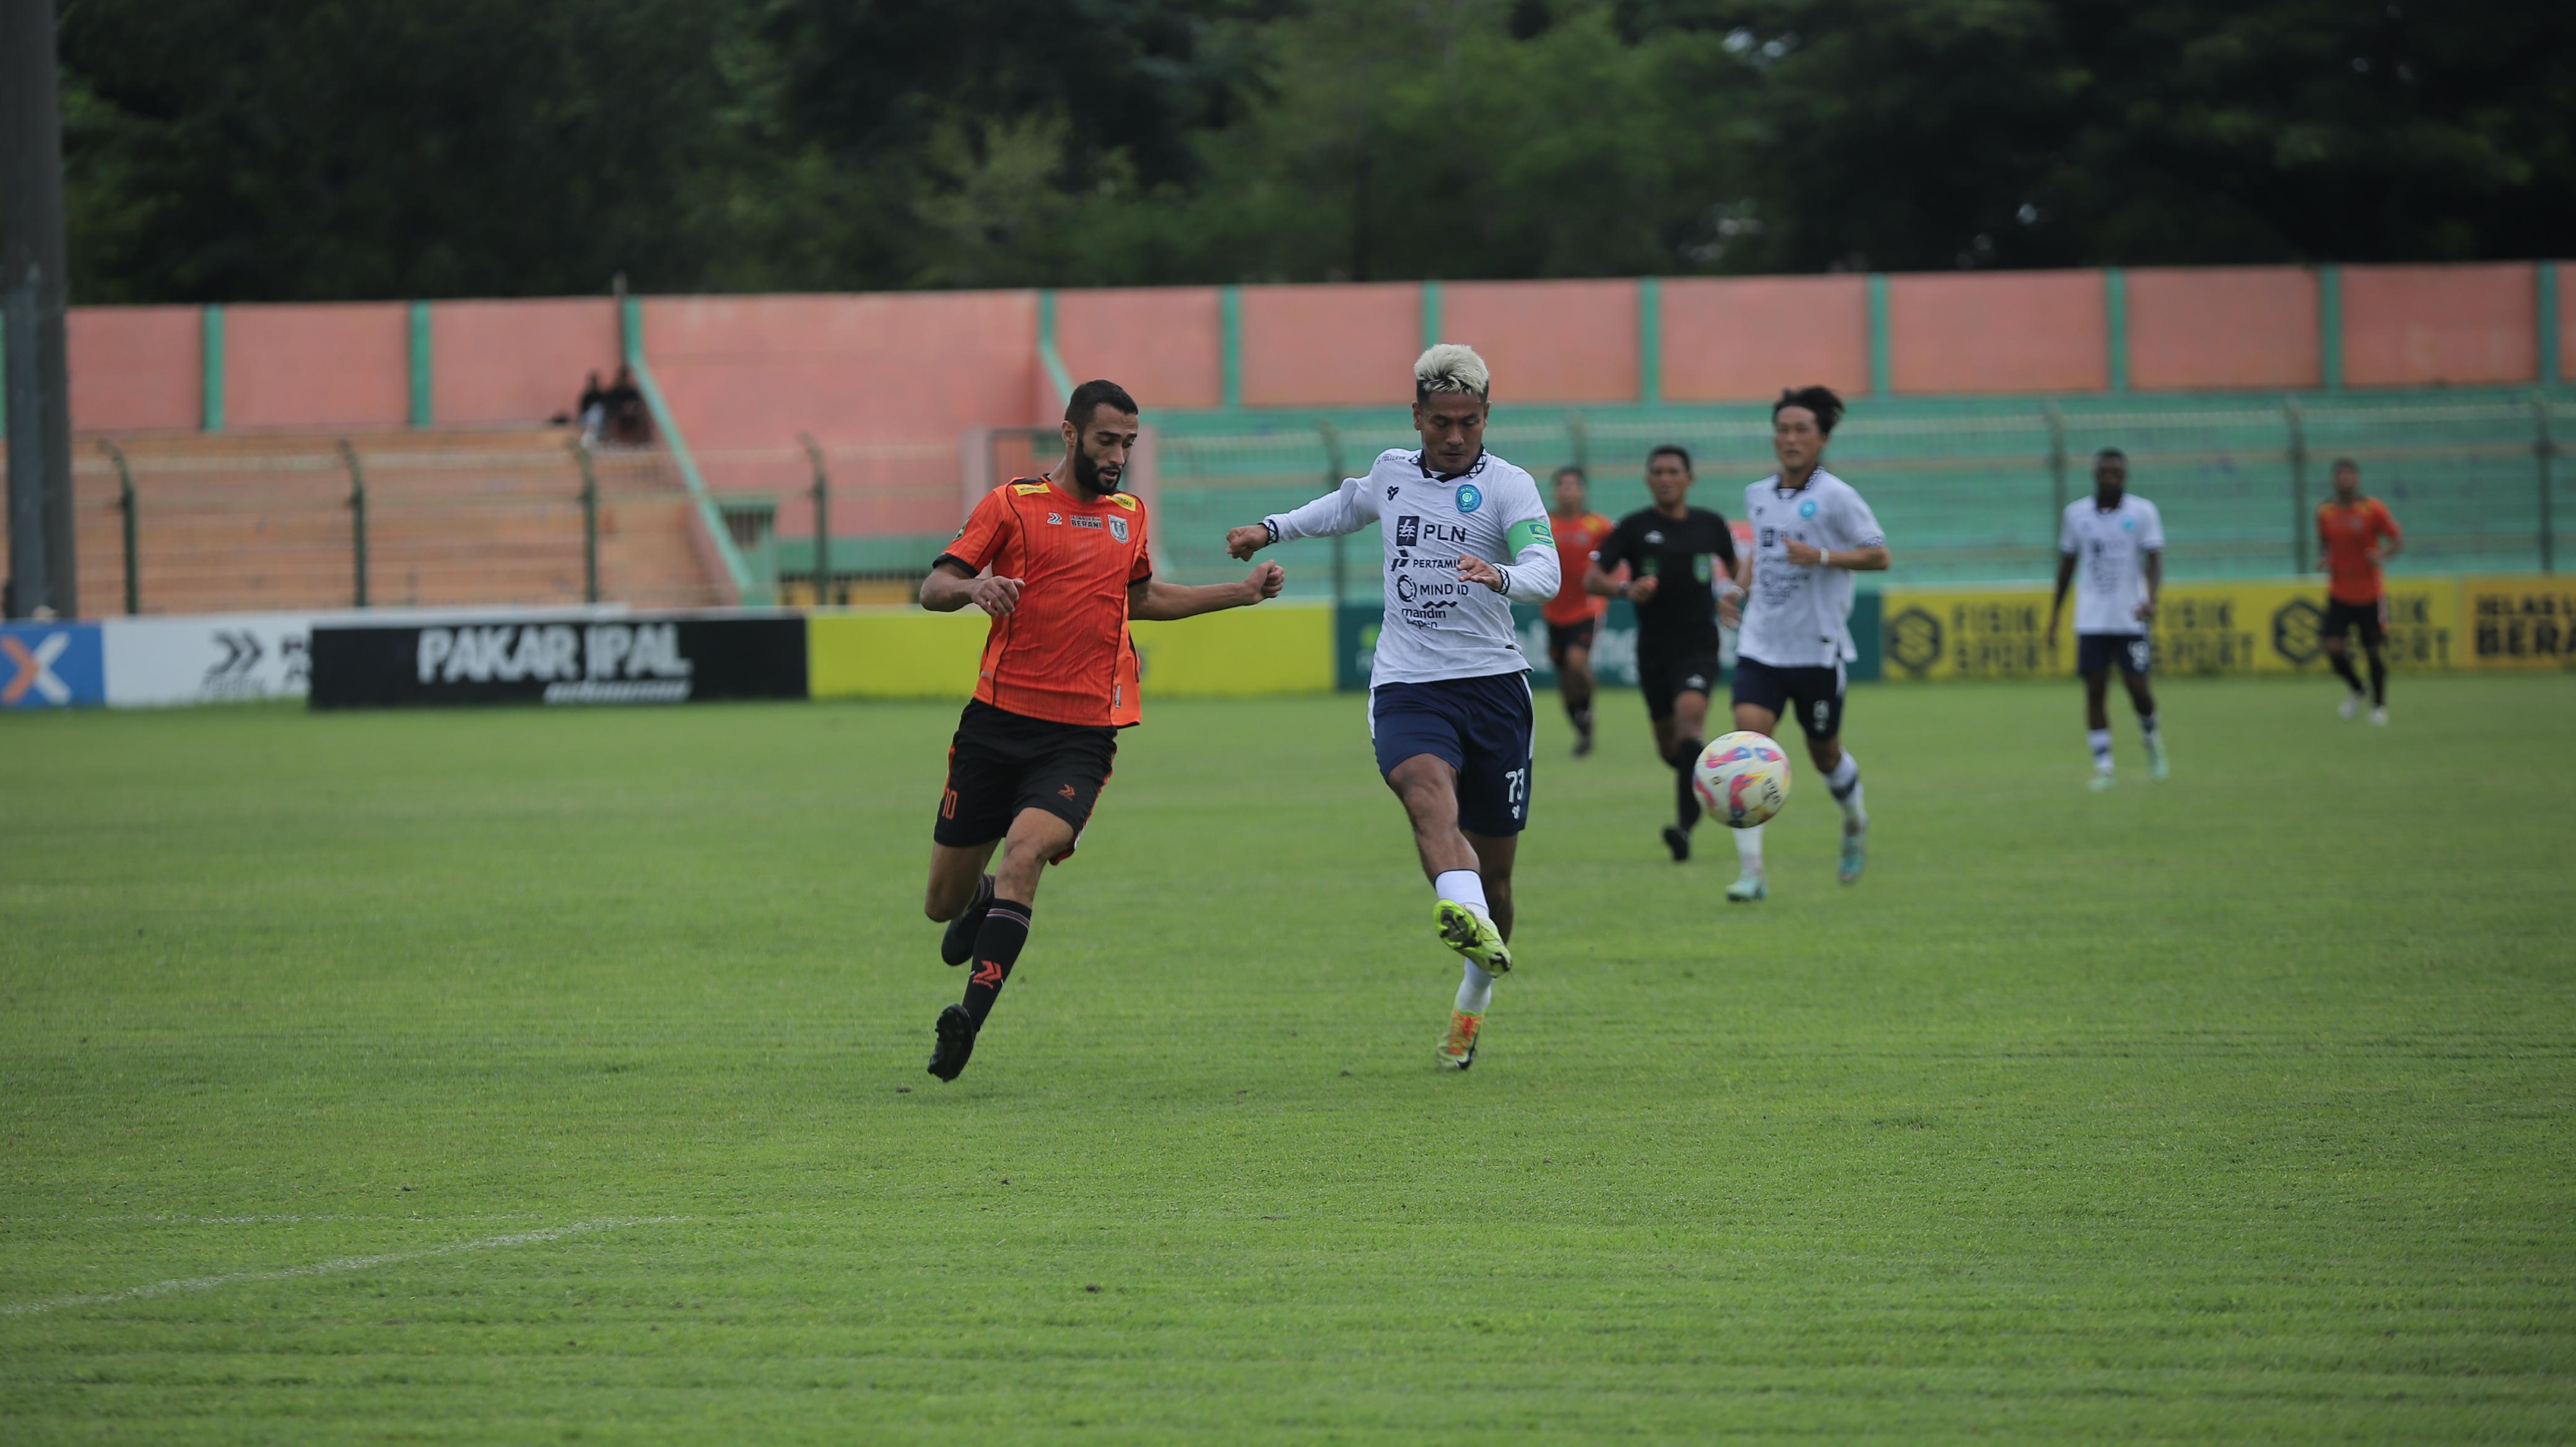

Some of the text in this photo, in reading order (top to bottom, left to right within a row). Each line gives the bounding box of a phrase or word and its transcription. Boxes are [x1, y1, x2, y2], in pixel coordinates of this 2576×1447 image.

[1071, 520, 1101, 528] BERANI
[1424, 525, 1466, 542] PLN
[1420, 584, 1468, 595] MIND ID
[1402, 608, 1447, 618] mandiri
[417, 624, 581, 683] PAKAR
[584, 622, 694, 680] IPAL
[1505, 768, 1525, 803] 73
[942, 788, 957, 820] 10
